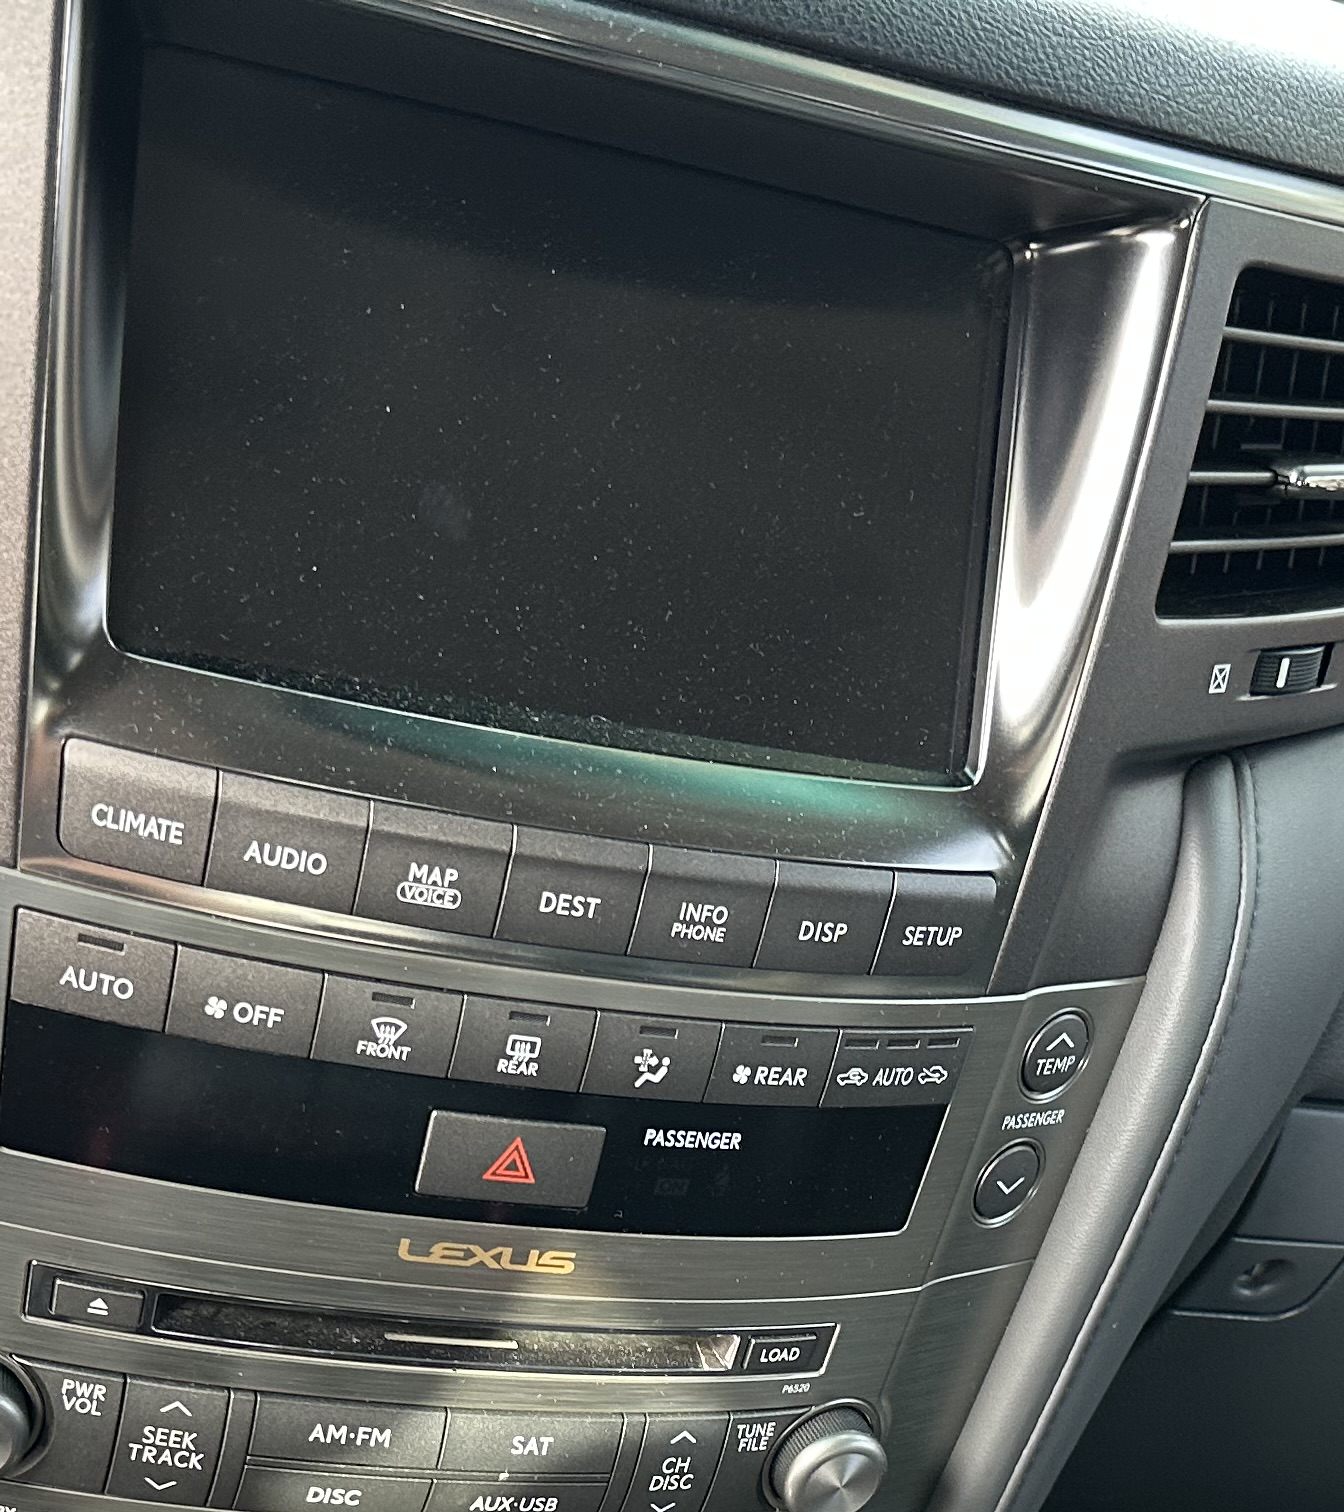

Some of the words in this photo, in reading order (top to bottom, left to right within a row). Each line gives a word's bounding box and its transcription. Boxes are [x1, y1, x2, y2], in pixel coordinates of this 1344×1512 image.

[91, 803, 185, 845] CLIMATE
[243, 840, 328, 875] AUDIO
[408, 861, 459, 886] MAP
[403, 886, 455, 905] VOICE
[538, 891, 602, 919] DEST
[678, 901, 729, 925] INFO
[670, 921, 727, 943] PHONE
[798, 920, 848, 943] DISP
[902, 925, 963, 947] SETUP
[59, 965, 134, 1000] AUTO
[232, 1001, 285, 1028] OFF
[356, 1039, 412, 1062] FRONT
[496, 1057, 539, 1077] REAR
[753, 1065, 808, 1087] REAR
[872, 1066, 914, 1087] AUTO
[1036, 1055, 1075, 1076] TEMP
[1001, 1109, 1065, 1131] PASSENGER
[643, 1128, 742, 1150] PASSENGER
[397, 1237, 577, 1275] LEXUS
[759, 1347, 801, 1363] LOAD
[61, 1378, 107, 1402] PWR
[62, 1395, 102, 1417] VOL
[141, 1425, 198, 1451] SEEK
[737, 1421, 777, 1439] TUNE
[510, 1435, 555, 1456] SAT
[737, 1437, 770, 1453] FILE
[128, 1442, 205, 1471] TRACK
[662, 1456, 692, 1475] CH
[648, 1474, 694, 1492] DISC
[305, 1486, 362, 1506] DISC
